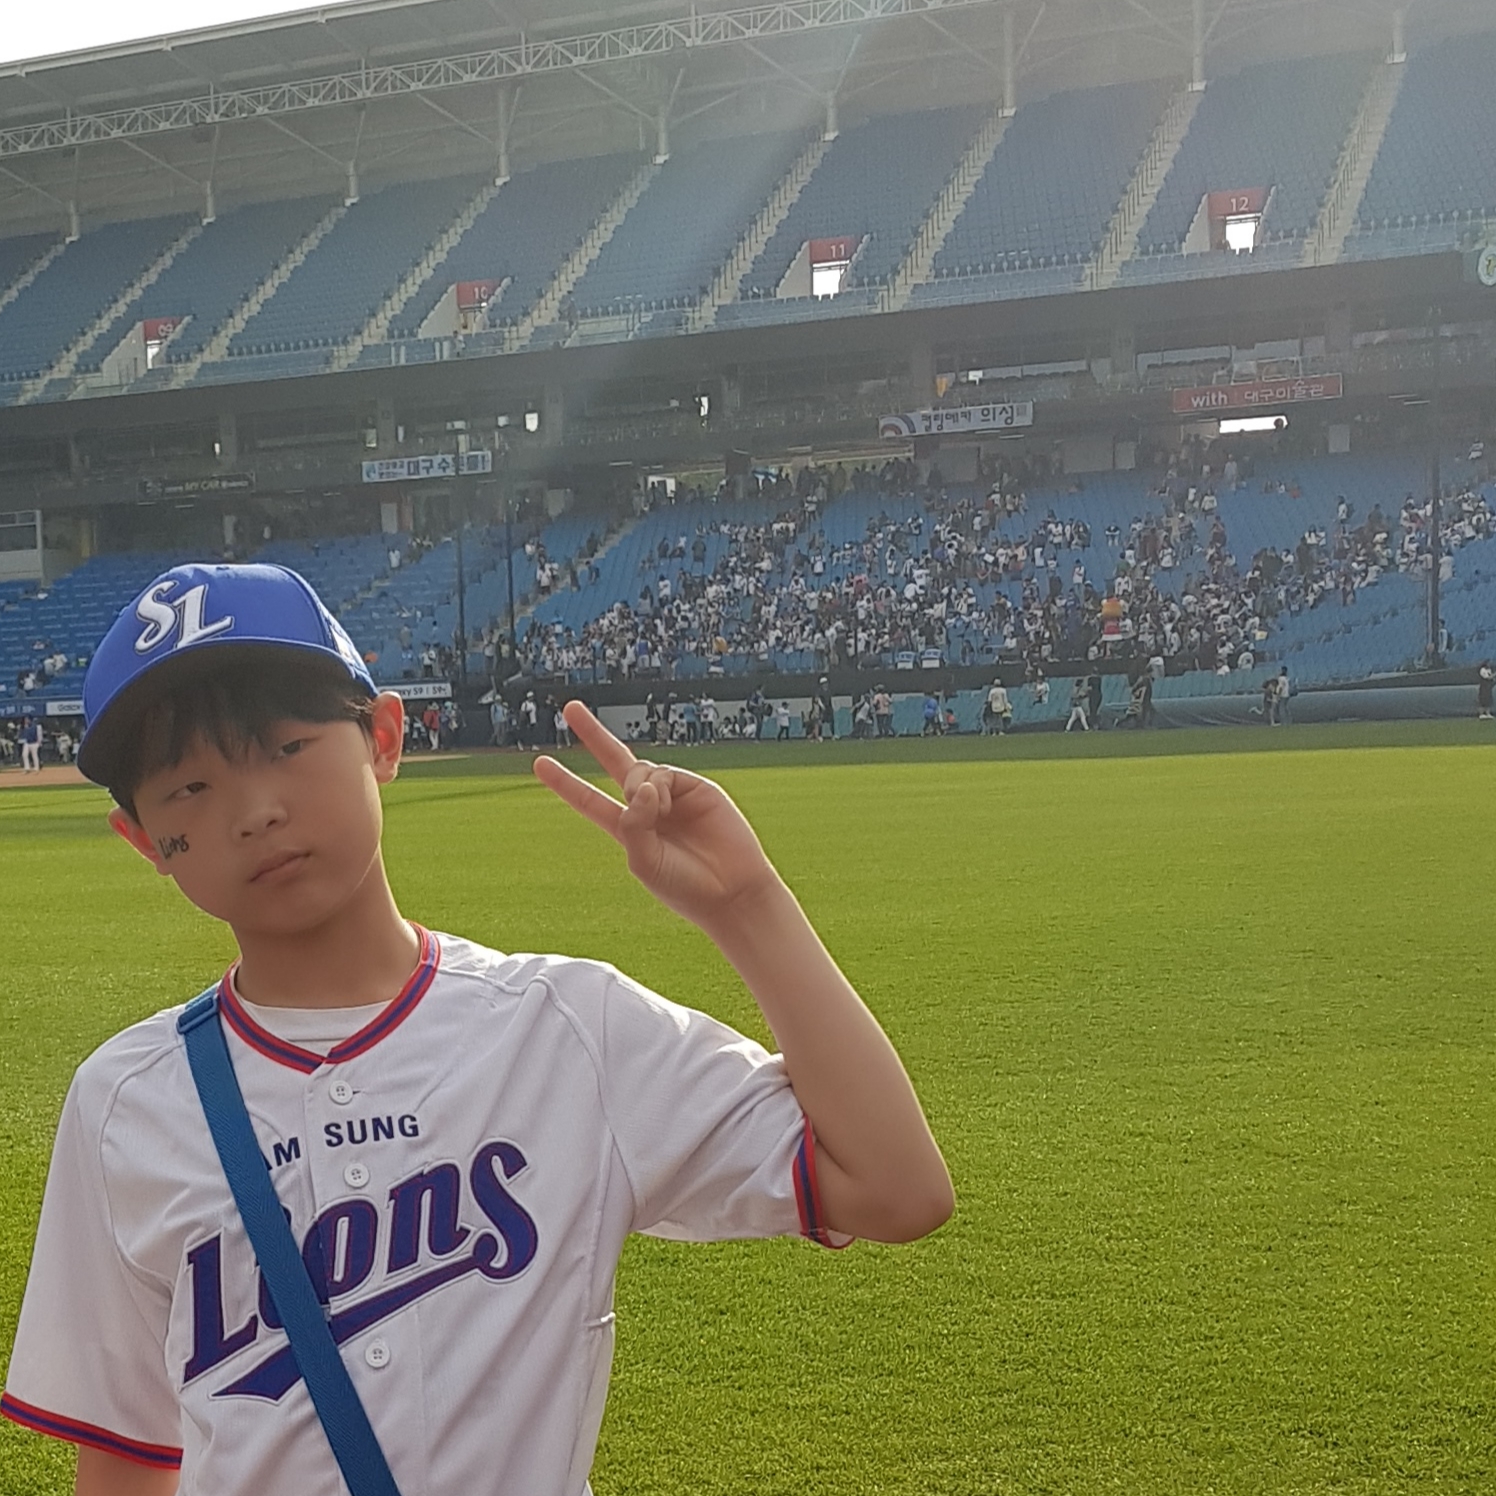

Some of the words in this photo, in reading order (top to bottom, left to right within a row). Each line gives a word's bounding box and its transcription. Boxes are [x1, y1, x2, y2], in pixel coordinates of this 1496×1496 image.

[1230, 196, 1249, 212] 12
[830, 243, 845, 258] 11
[474, 286, 488, 300] 10
[1191, 391, 1228, 408] with
[980, 405, 1014, 426] 의성
[135, 580, 234, 655] SL
[323, 1113, 420, 1148] SUNG
